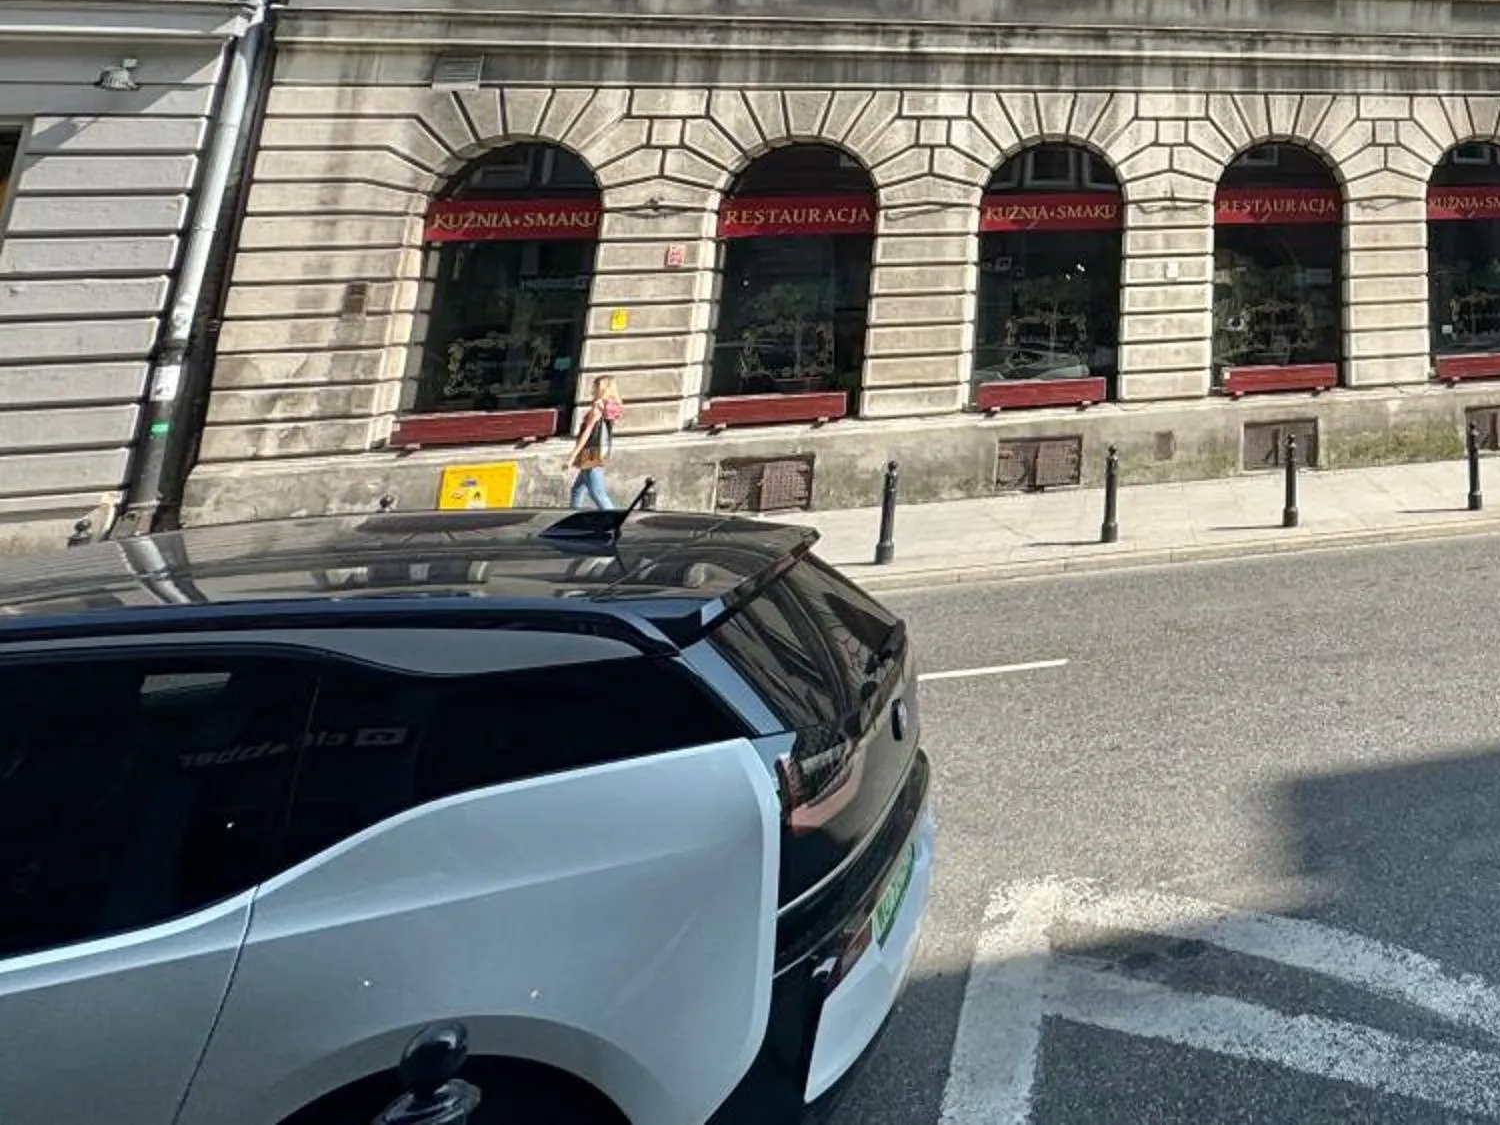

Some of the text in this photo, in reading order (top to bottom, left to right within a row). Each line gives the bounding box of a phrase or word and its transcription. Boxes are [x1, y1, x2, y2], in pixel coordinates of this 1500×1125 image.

[1056, 204, 1117, 220] SMAKU
[1219, 197, 1337, 216] RESTAURACJA
[523, 211, 599, 228] SMAKU
[724, 207, 871, 228] RESTAURACJA
